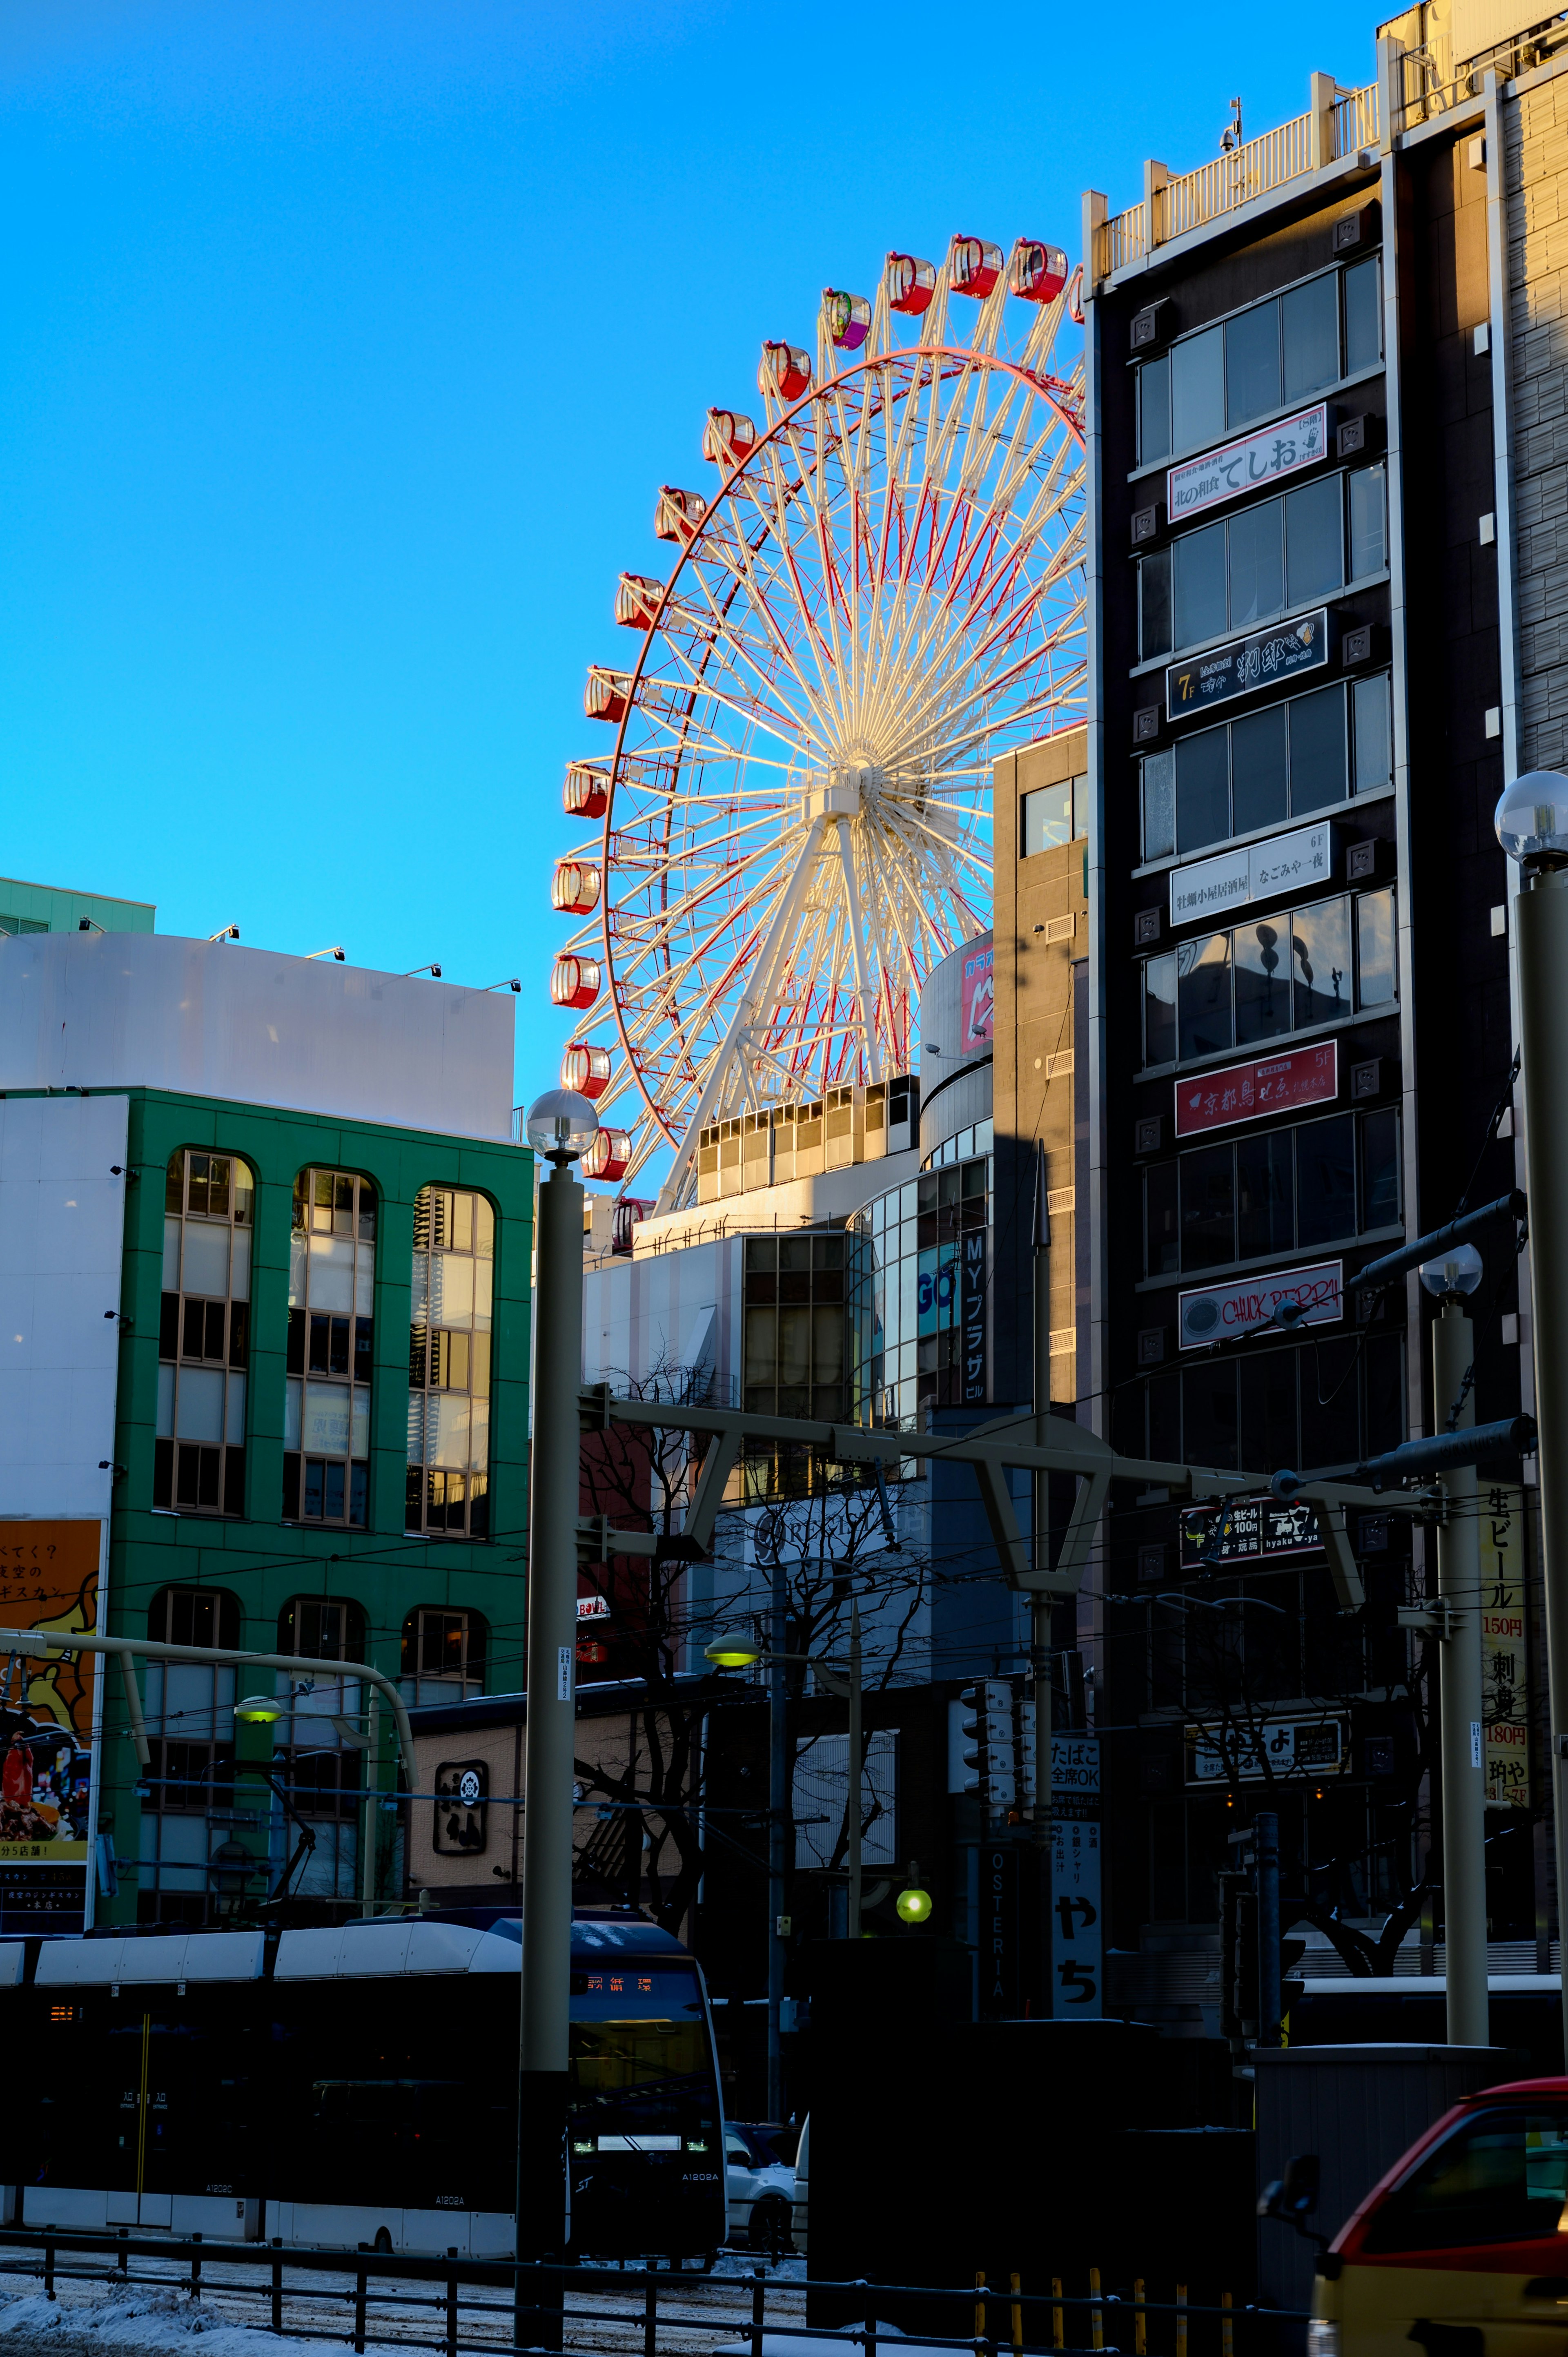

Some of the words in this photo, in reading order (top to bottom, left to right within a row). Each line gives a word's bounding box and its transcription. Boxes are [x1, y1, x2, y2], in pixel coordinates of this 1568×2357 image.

[1175, 476, 1219, 507] 北の和食
[1219, 439, 1296, 488] てしお
[1311, 833, 1324, 848] 6F
[1177, 875, 1248, 911] 牡蠣小屋居酒屋
[1260, 852, 1323, 884] なごみや一夜
[1315, 1049, 1331, 1067] 5F
[1293, 1075, 1325, 1093] 札幌本店
[1223, 1293, 1270, 1325] CHUCK
[1234, 1508, 1257, 1521] 生ビール
[1234, 1521, 1258, 1534] 100円
[1489, 1488, 1512, 1609] 生ビール
[1483, 1617, 1521, 1637] 150円
[1487, 1726, 1526, 1746] 180円
[1051, 1742, 1098, 1765] たばこ
[1051, 1766, 1099, 1787] 全席OK
[1051, 1794, 1100, 1806] お席で紙たばこ
[1056, 1835, 1065, 1873] お出汁
[1072, 1836, 1081, 1884] 銀シャリ
[8, 1891, 80, 1899] 夜空のジンギスカン
[992, 1853, 1004, 1998] OSTERIA
[1055, 1895, 1097, 2004] やち
[123, 2092, 134, 2101] 入口
[156, 2092, 166, 2102] 入口
[206, 2184, 232, 2193] A1202C
[435, 2196, 465, 2205] A1202A
